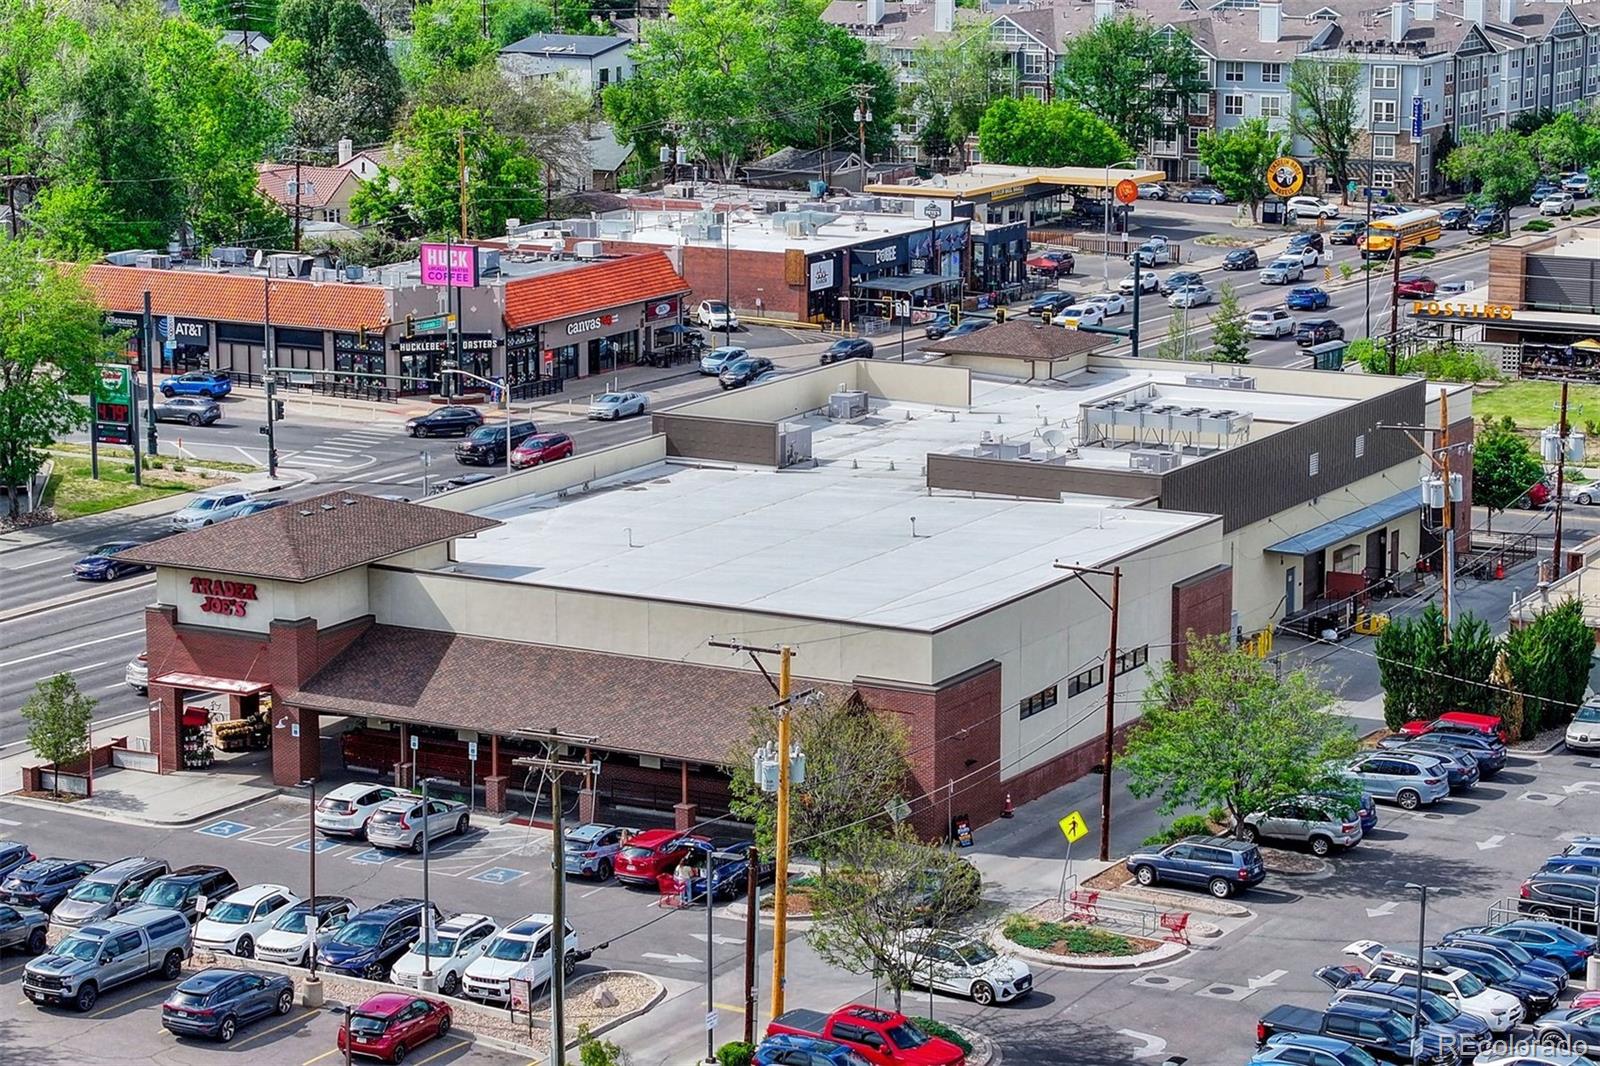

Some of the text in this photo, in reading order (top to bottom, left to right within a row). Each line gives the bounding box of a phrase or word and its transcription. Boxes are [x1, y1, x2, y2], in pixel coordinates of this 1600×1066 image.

[427, 249, 468, 266] HUCK
[428, 272, 469, 282] COFFEE
[1413, 301, 1513, 319] POSTINO
[175, 322, 203, 337] AT&T
[567, 317, 601, 335] canvas
[190, 577, 258, 600] TRADER
[200, 597, 247, 617] JOE'S
